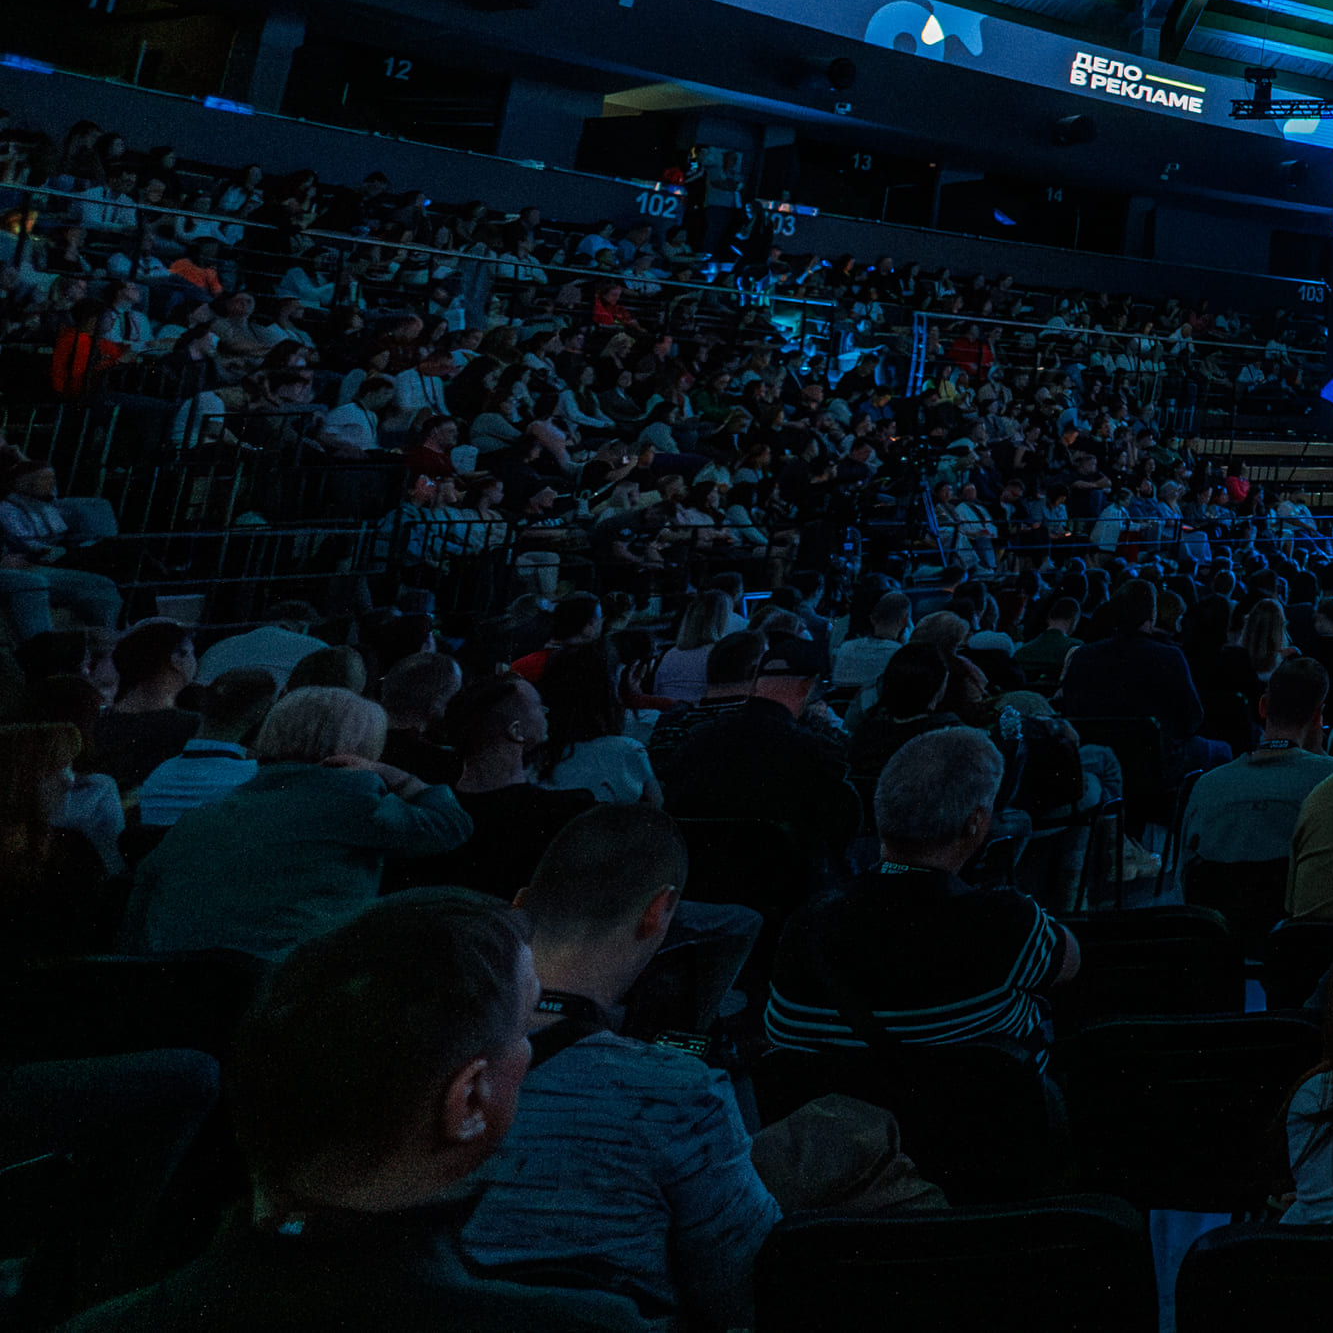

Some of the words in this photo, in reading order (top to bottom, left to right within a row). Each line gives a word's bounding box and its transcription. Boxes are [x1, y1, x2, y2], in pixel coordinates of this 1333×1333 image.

[384, 55, 413, 81] 12
[1072, 51, 1143, 82] ДЕЛО
[1070, 68, 1088, 86] В
[1090, 74, 1204, 114] РЕКЛАМЕ
[851, 152, 872, 171] 13
[636, 192, 679, 219] 102
[1046, 186, 1064, 202] 14
[1297, 284, 1324, 303] 103
